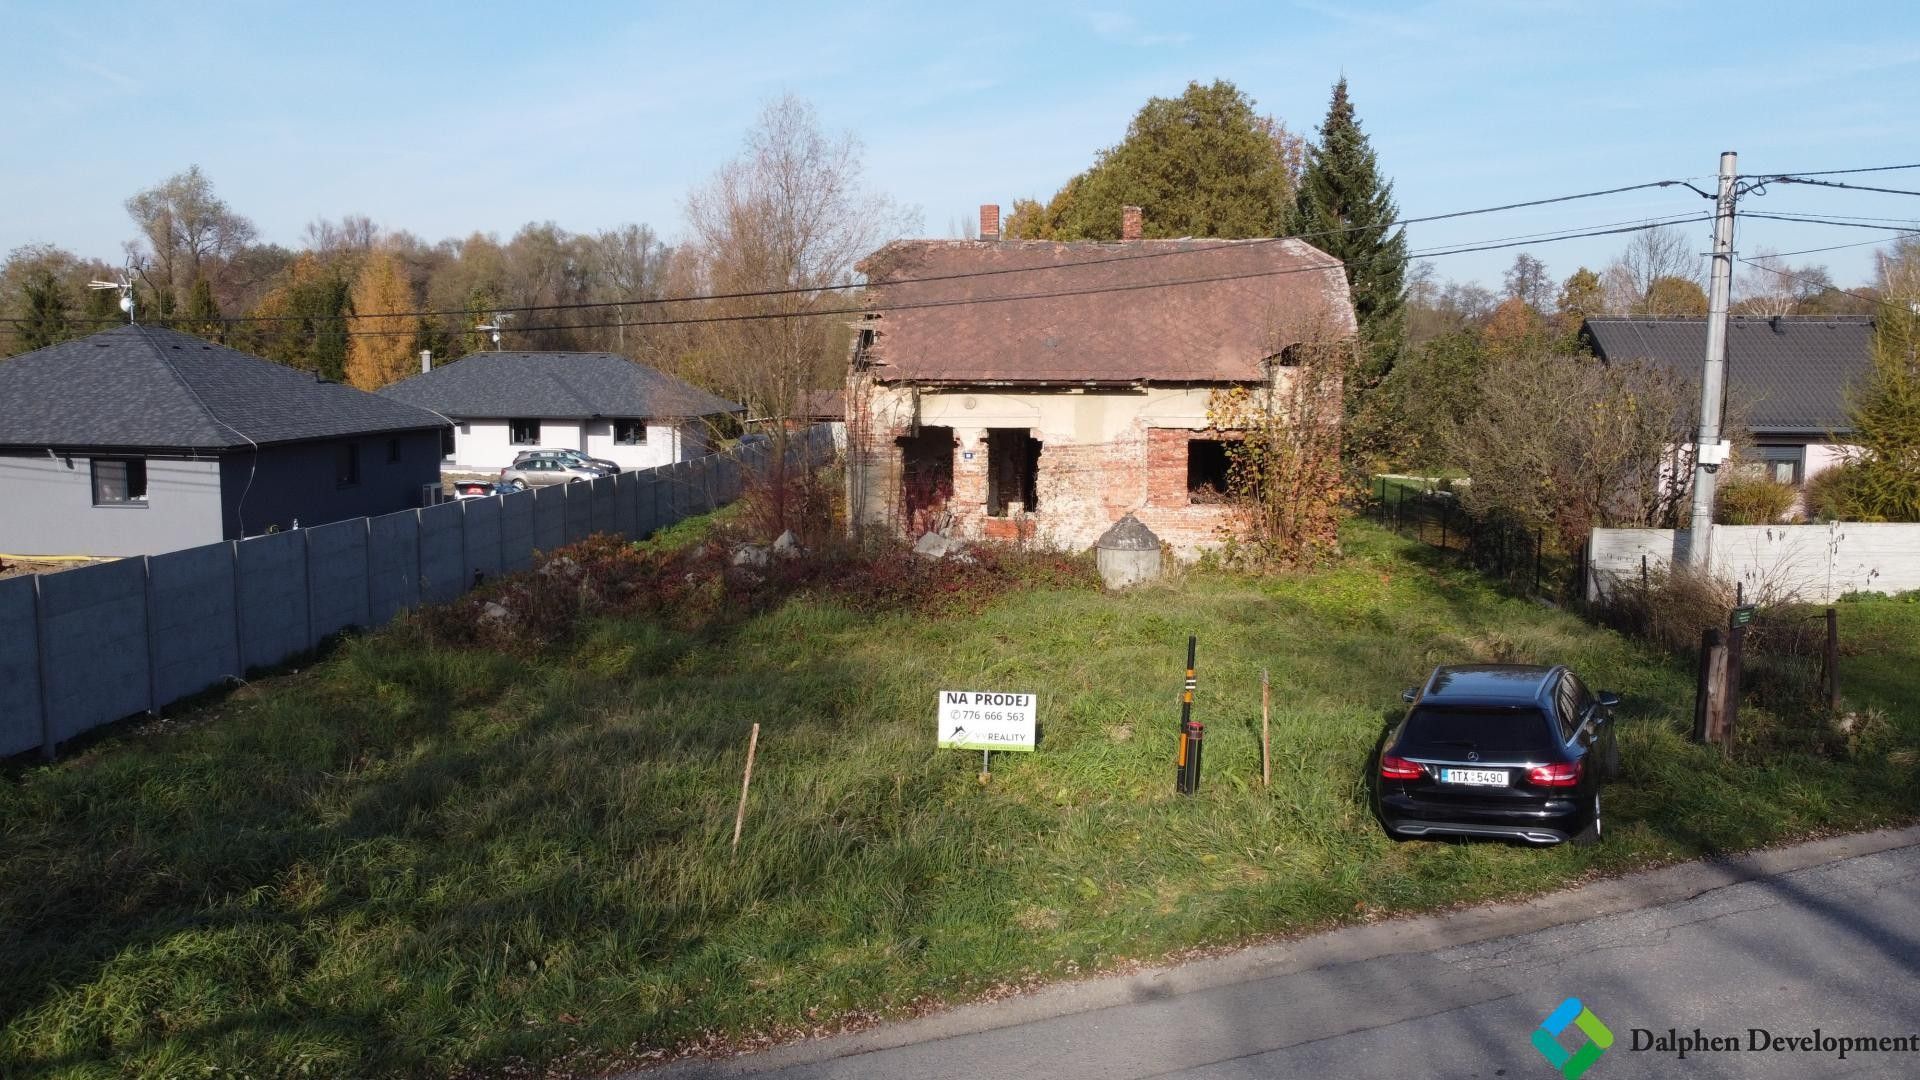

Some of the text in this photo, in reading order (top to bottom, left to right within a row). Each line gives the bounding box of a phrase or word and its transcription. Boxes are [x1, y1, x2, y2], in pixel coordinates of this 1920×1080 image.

[946, 692, 1029, 707] NA PRODEJ
[962, 710, 1025, 722] 776 666 563
[1476, 772, 1503, 783] 5490
